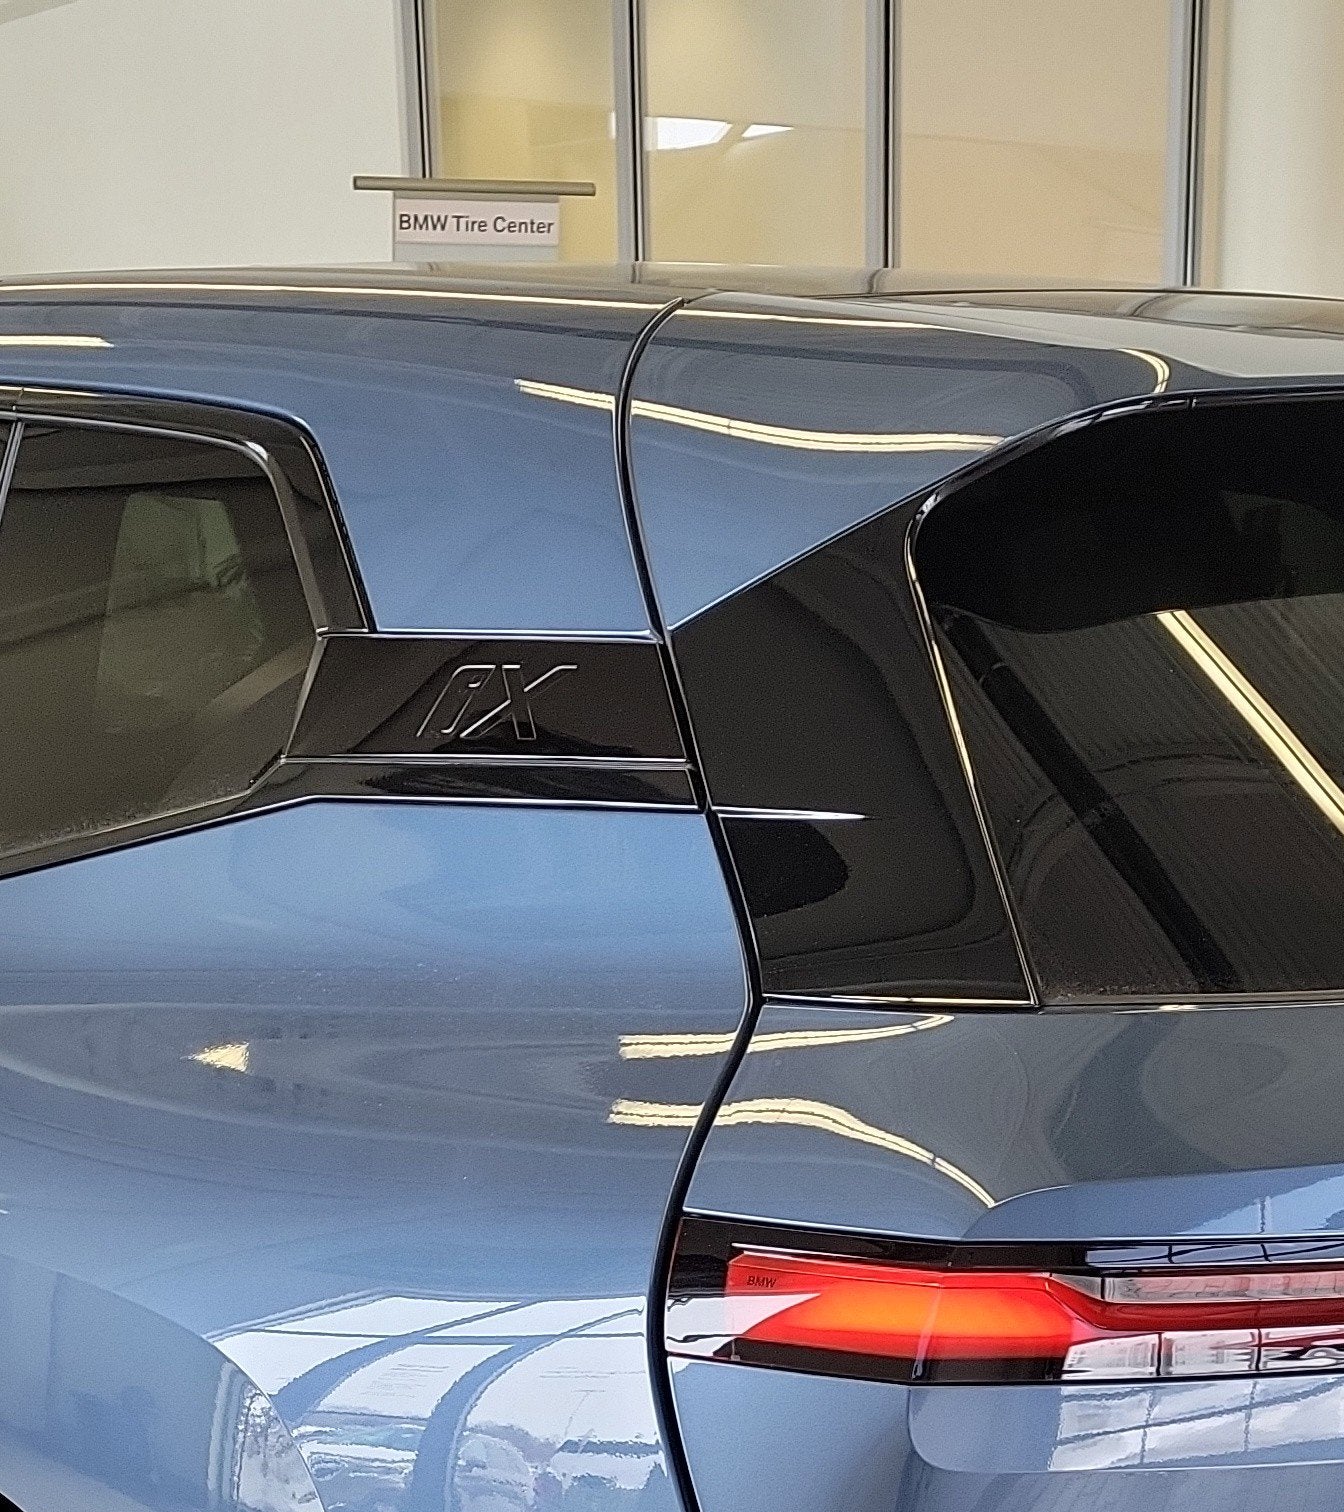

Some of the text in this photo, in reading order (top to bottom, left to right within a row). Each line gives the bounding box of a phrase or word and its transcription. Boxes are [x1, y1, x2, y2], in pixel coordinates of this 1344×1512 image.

[399, 213, 555, 234] BMW Tire Center
[416, 664, 579, 741] iX
[746, 1275, 777, 1288] BMW
